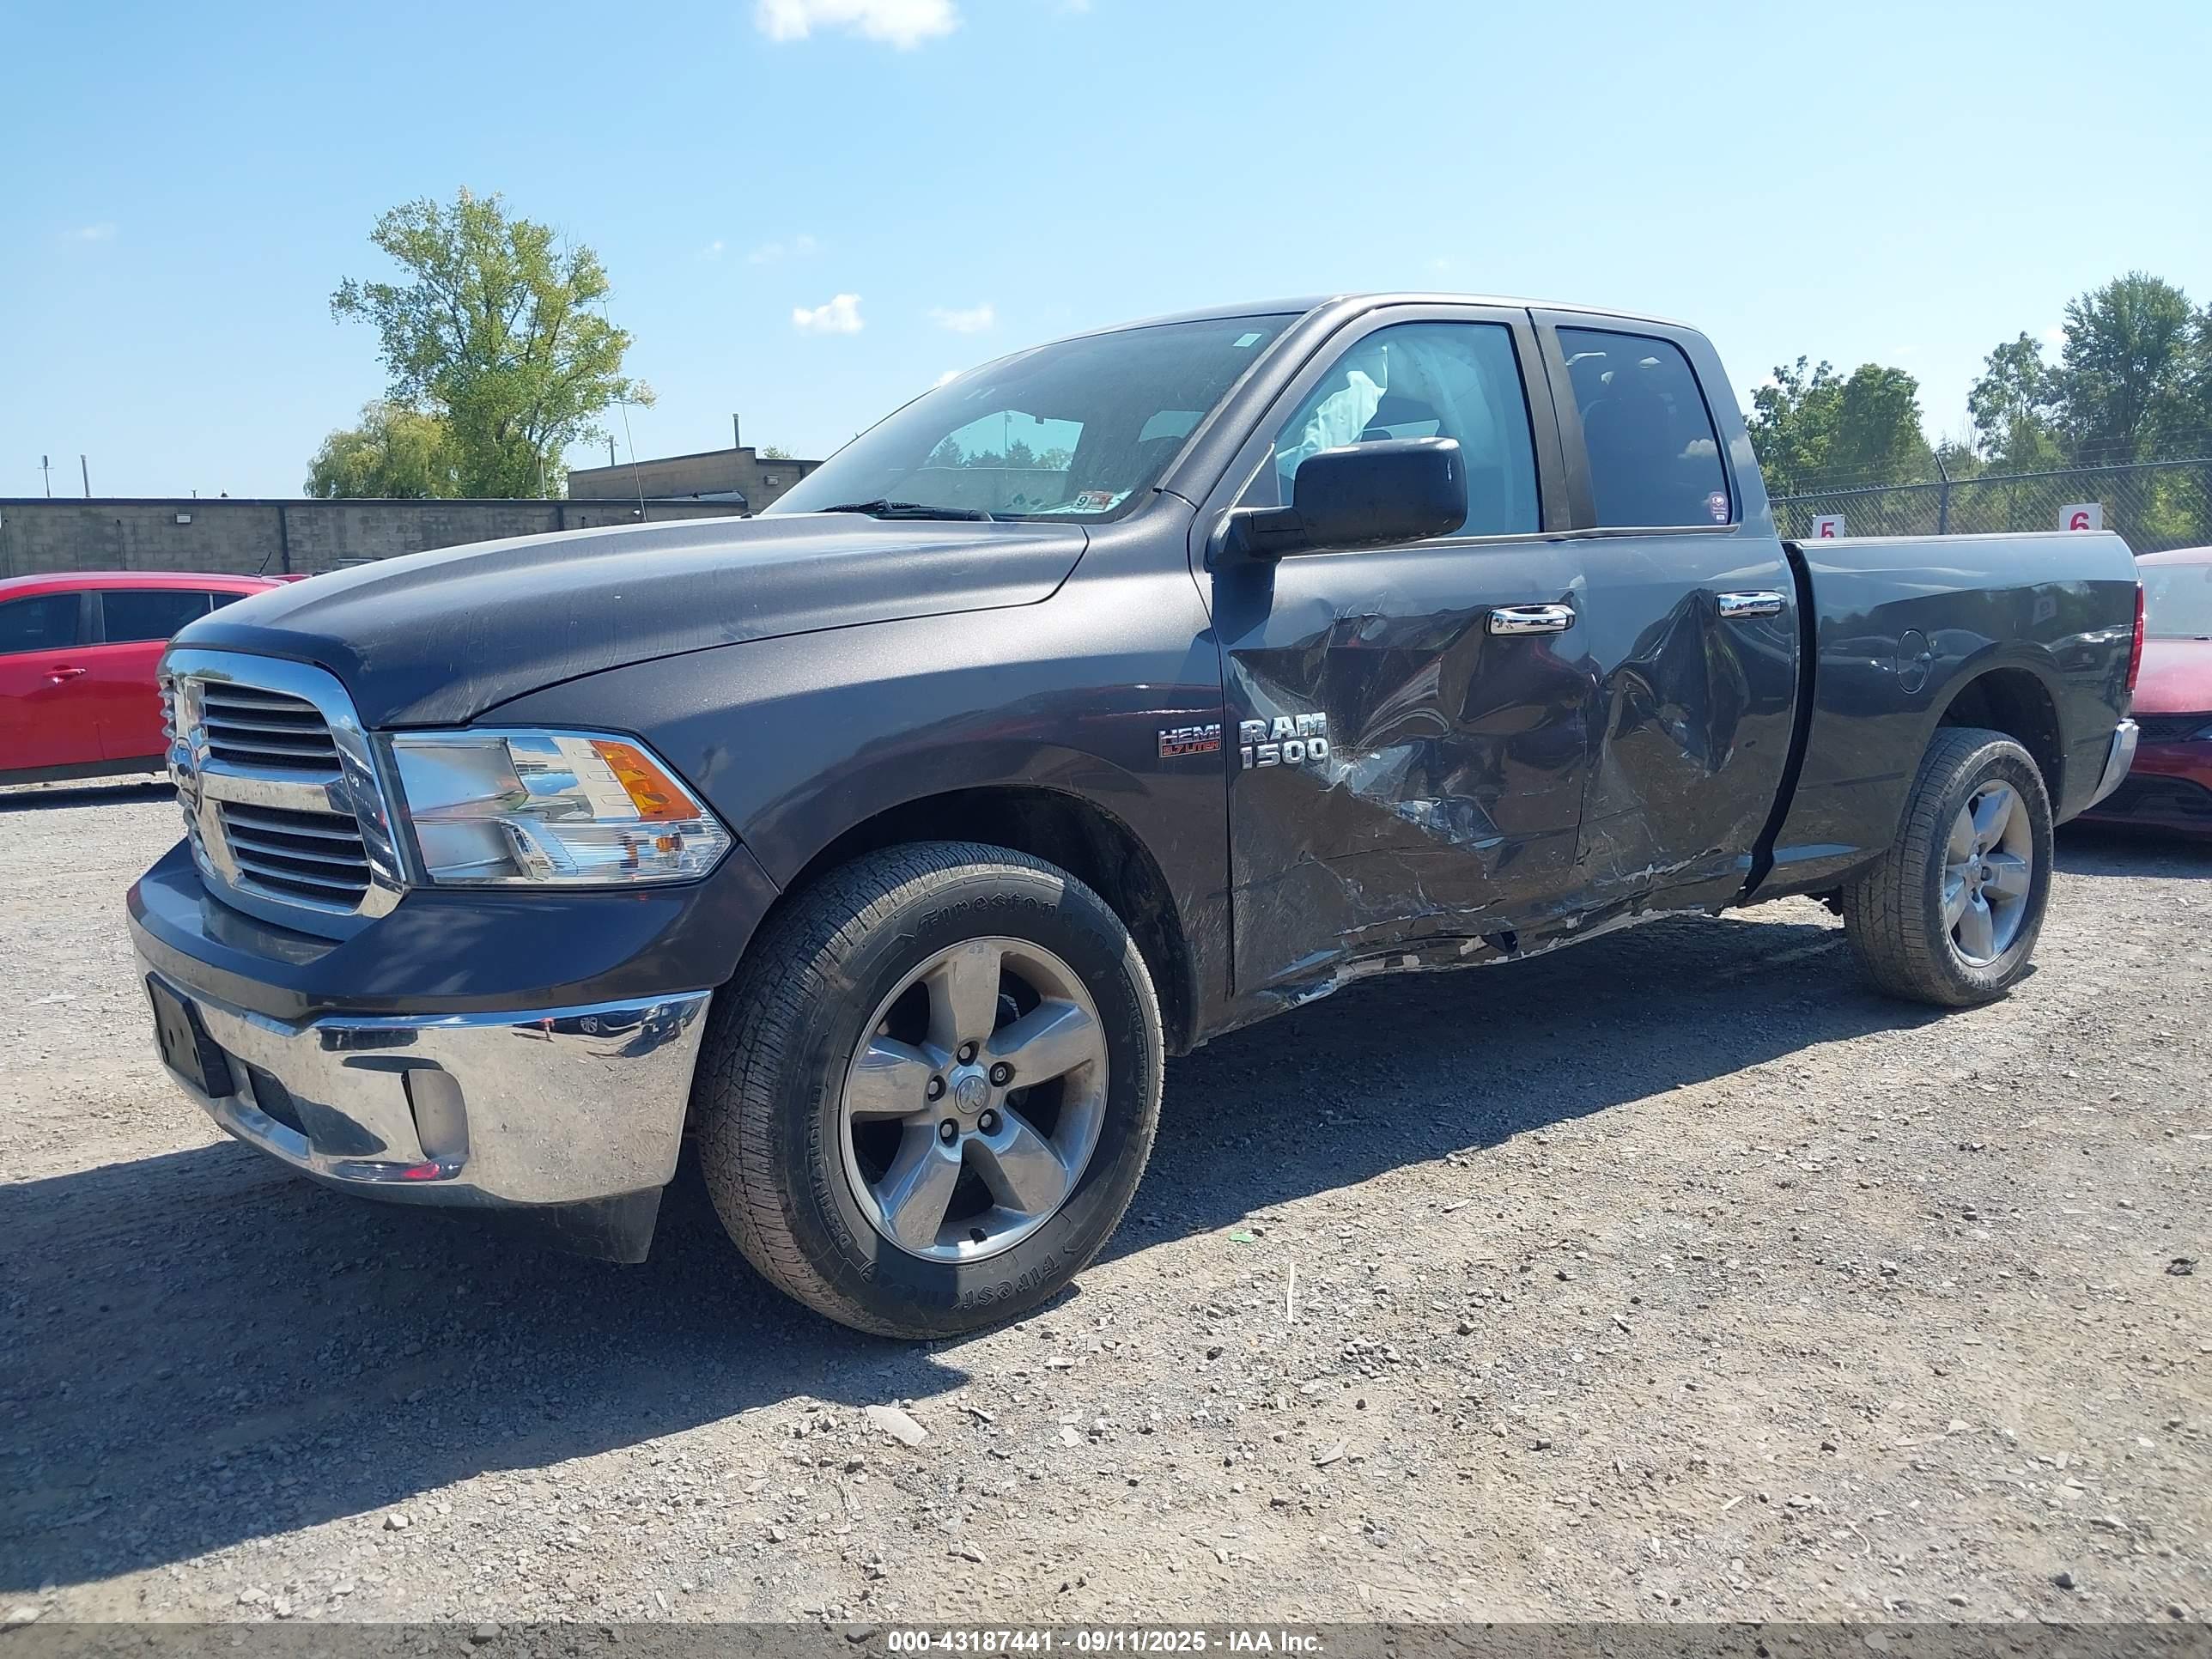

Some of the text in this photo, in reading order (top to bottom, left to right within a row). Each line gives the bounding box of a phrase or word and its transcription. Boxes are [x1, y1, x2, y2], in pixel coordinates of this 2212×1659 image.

[1821, 522, 1835, 538] 5
[2070, 512, 2088, 531] 6
[1160, 723, 1221, 745] HEMI
[1239, 712, 1327, 744] RAM
[1240, 738, 1329, 769] 1500
